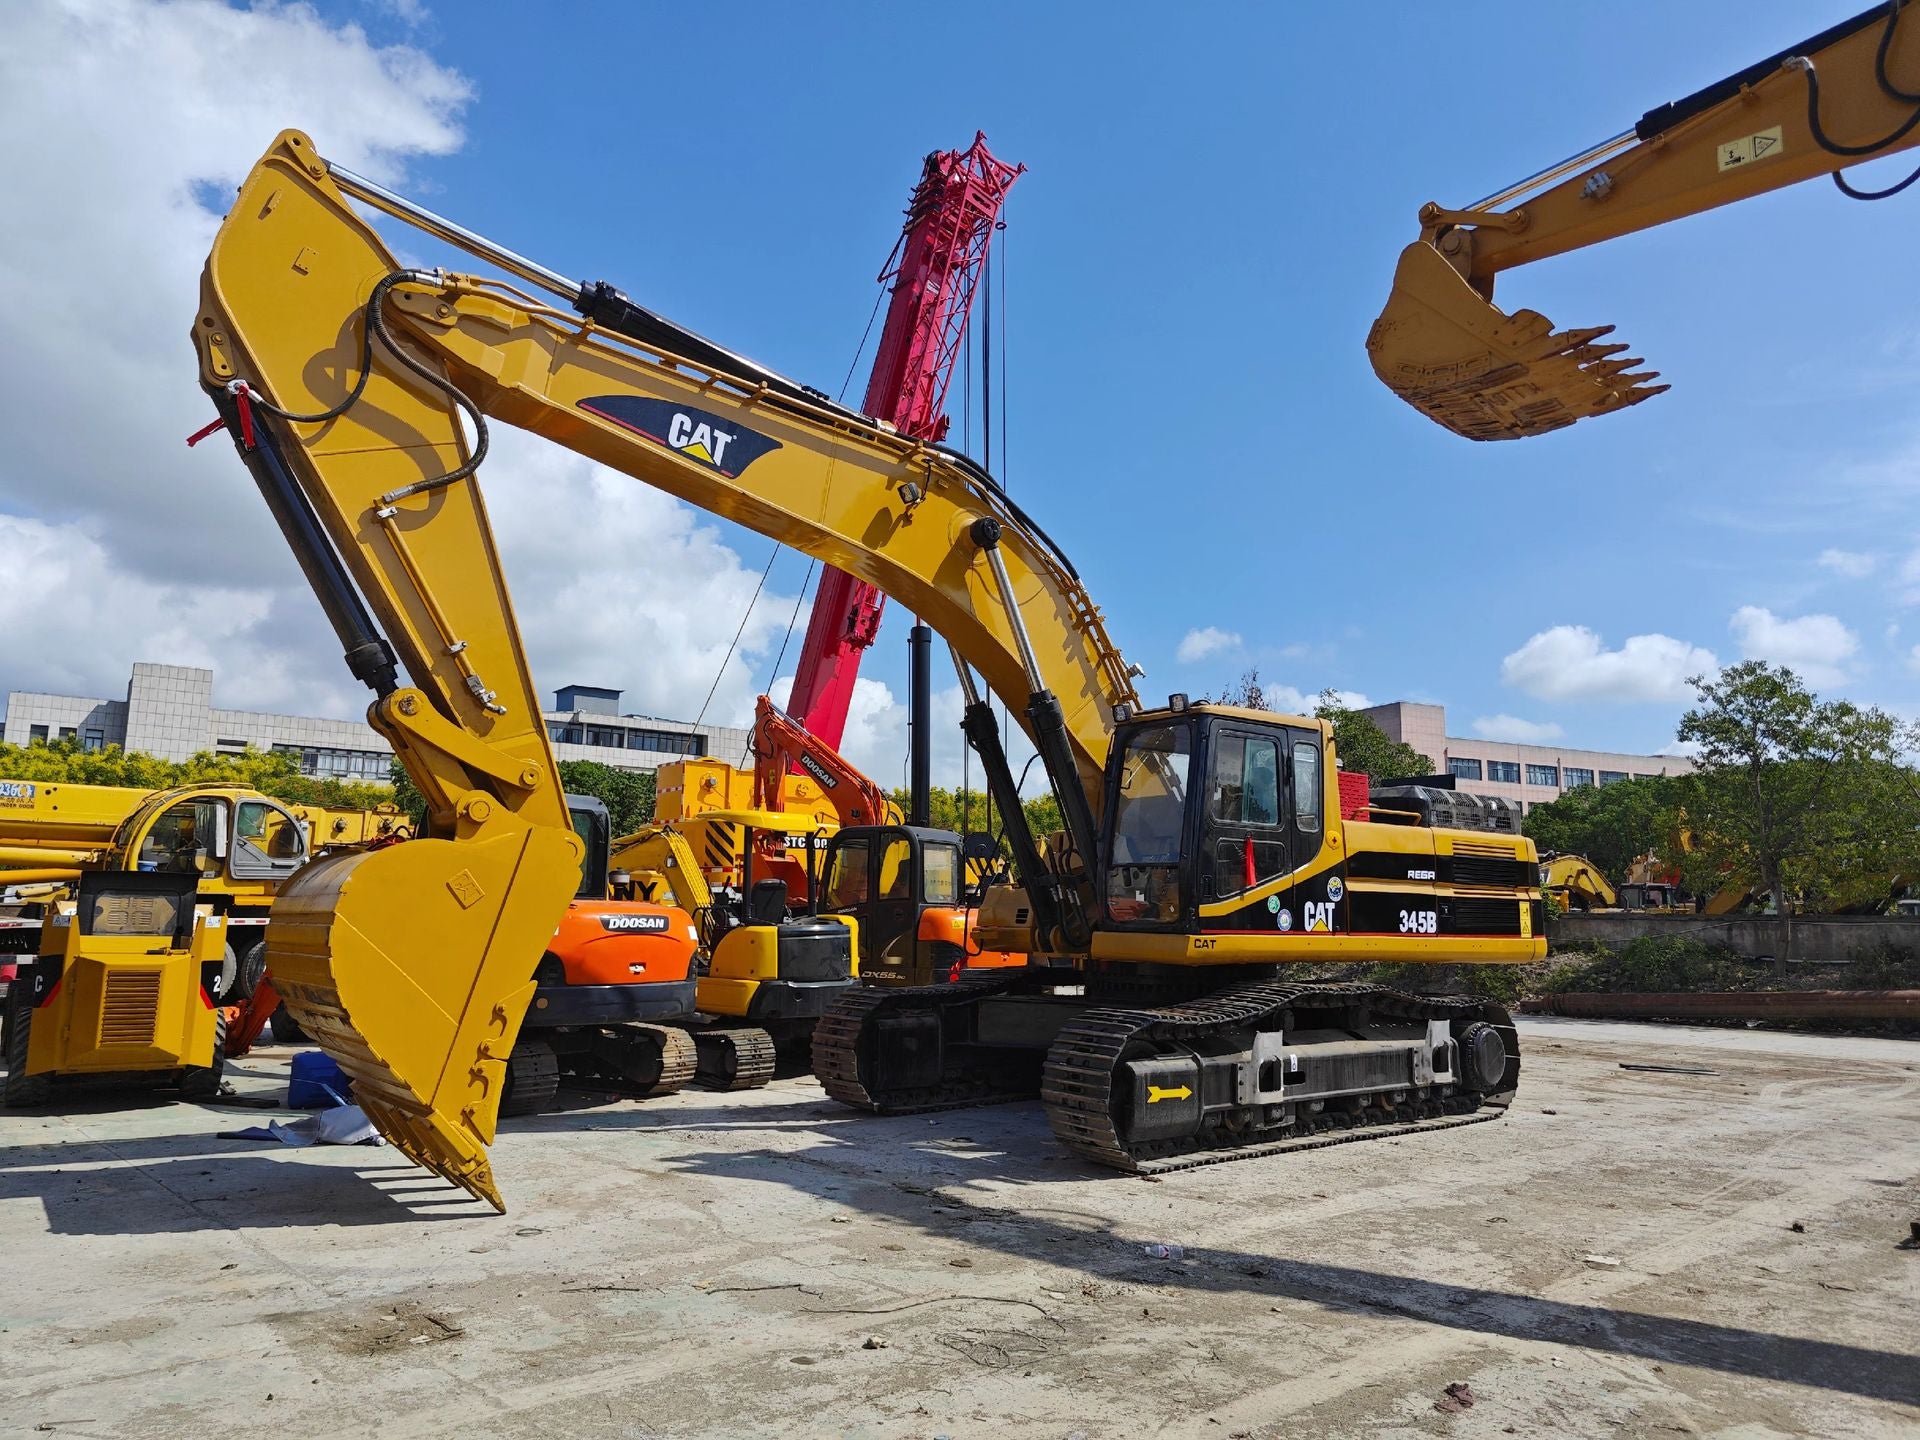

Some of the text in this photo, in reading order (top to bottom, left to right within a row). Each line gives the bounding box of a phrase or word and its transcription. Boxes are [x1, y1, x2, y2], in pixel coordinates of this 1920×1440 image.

[668, 413, 732, 466] CAT
[801, 755, 836, 788] DOOSAN
[1407, 870, 1435, 880] REGA
[609, 880, 658, 901] NY
[608, 918, 665, 929] DOOSAN
[1304, 900, 1336, 932] CAT
[1399, 909, 1437, 934] 345B
[1194, 938, 1217, 949] CAT
[34, 974, 43, 993] C
